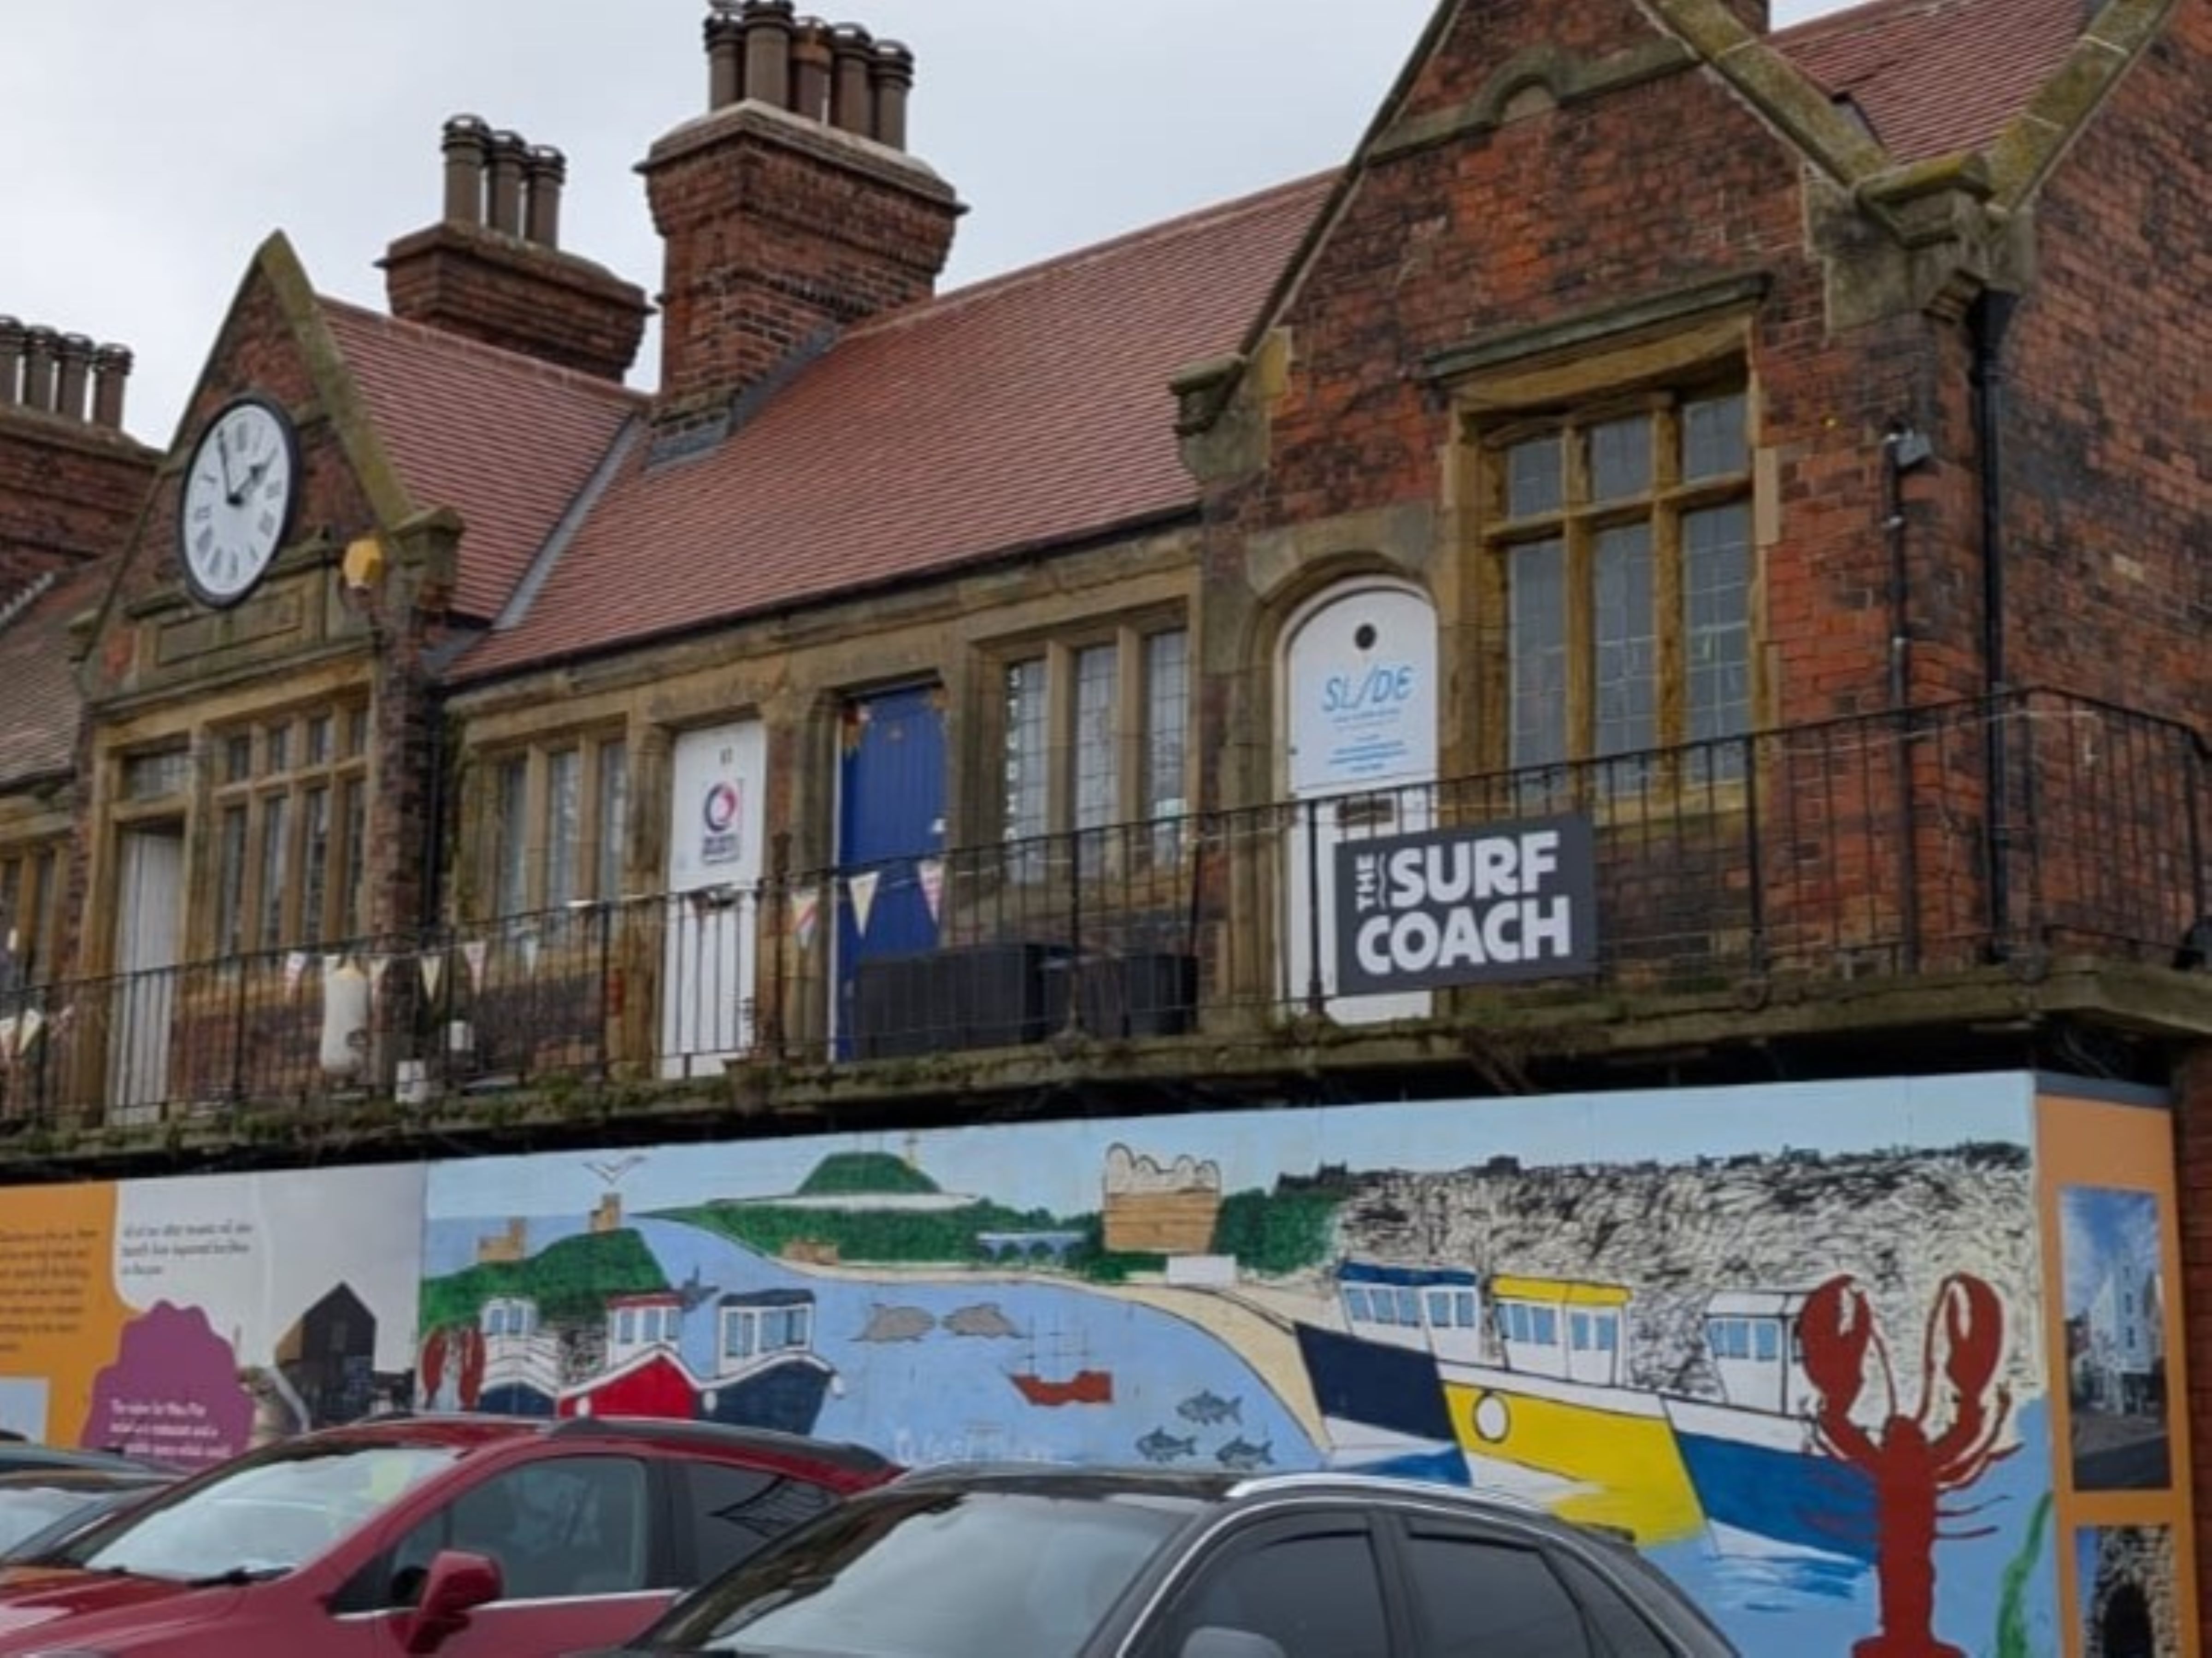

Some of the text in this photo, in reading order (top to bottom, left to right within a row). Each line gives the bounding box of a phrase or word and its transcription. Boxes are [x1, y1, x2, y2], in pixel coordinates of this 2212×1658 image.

[1356, 854, 1375, 912] THE
[1389, 831, 1559, 908] SURF
[1356, 896, 1570, 974] COACH
